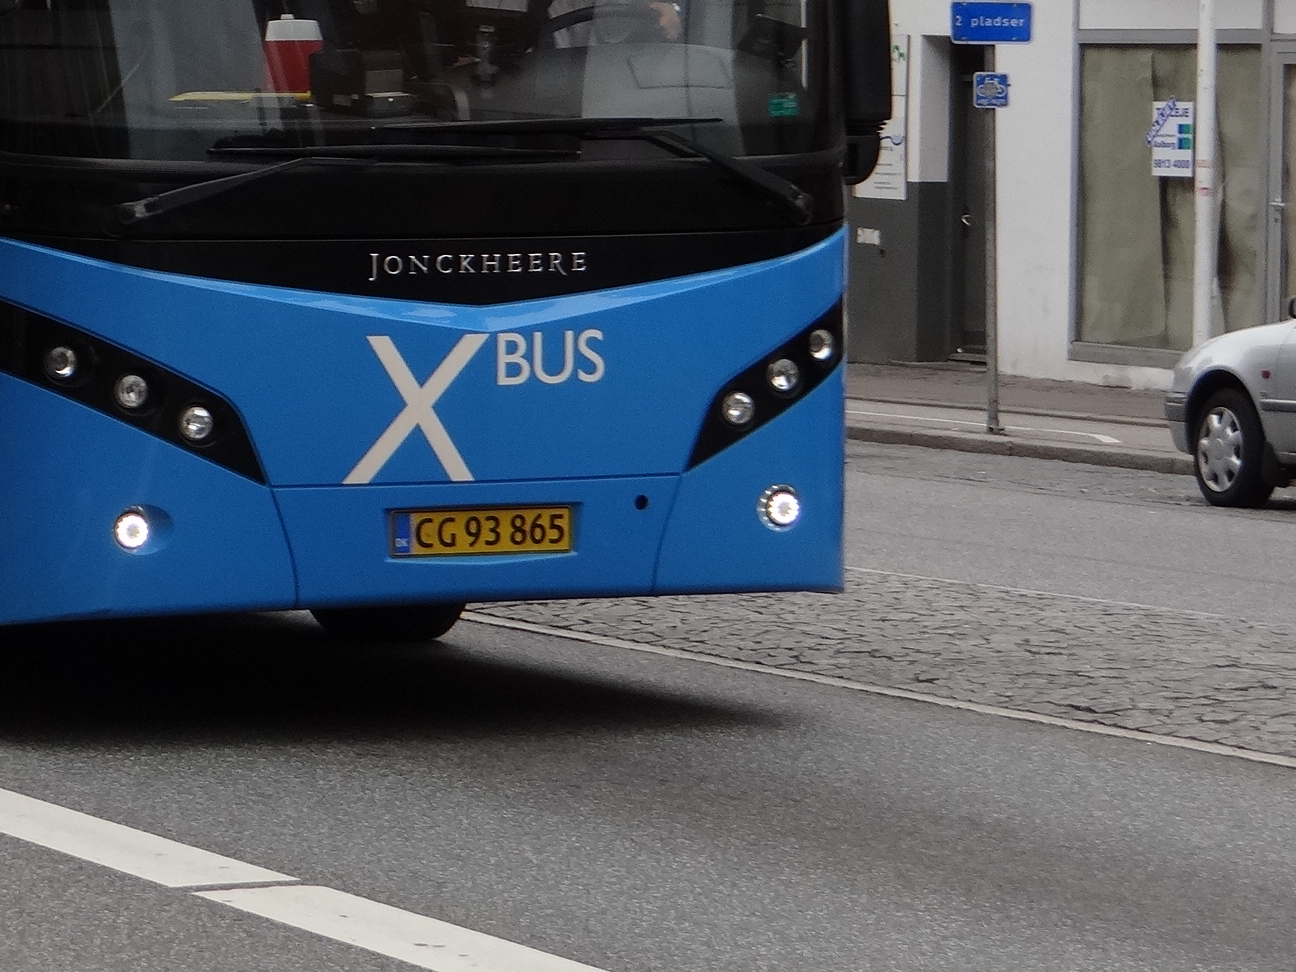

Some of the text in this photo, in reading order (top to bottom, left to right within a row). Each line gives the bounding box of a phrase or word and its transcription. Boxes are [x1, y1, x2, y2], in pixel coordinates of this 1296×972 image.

[954, 14, 1025, 29] 2 pladser
[368, 251, 588, 281] JONCKHEERE
[496, 328, 605, 386] BUS
[340, 333, 491, 485] X
[414, 513, 565, 548] CG 93 865
